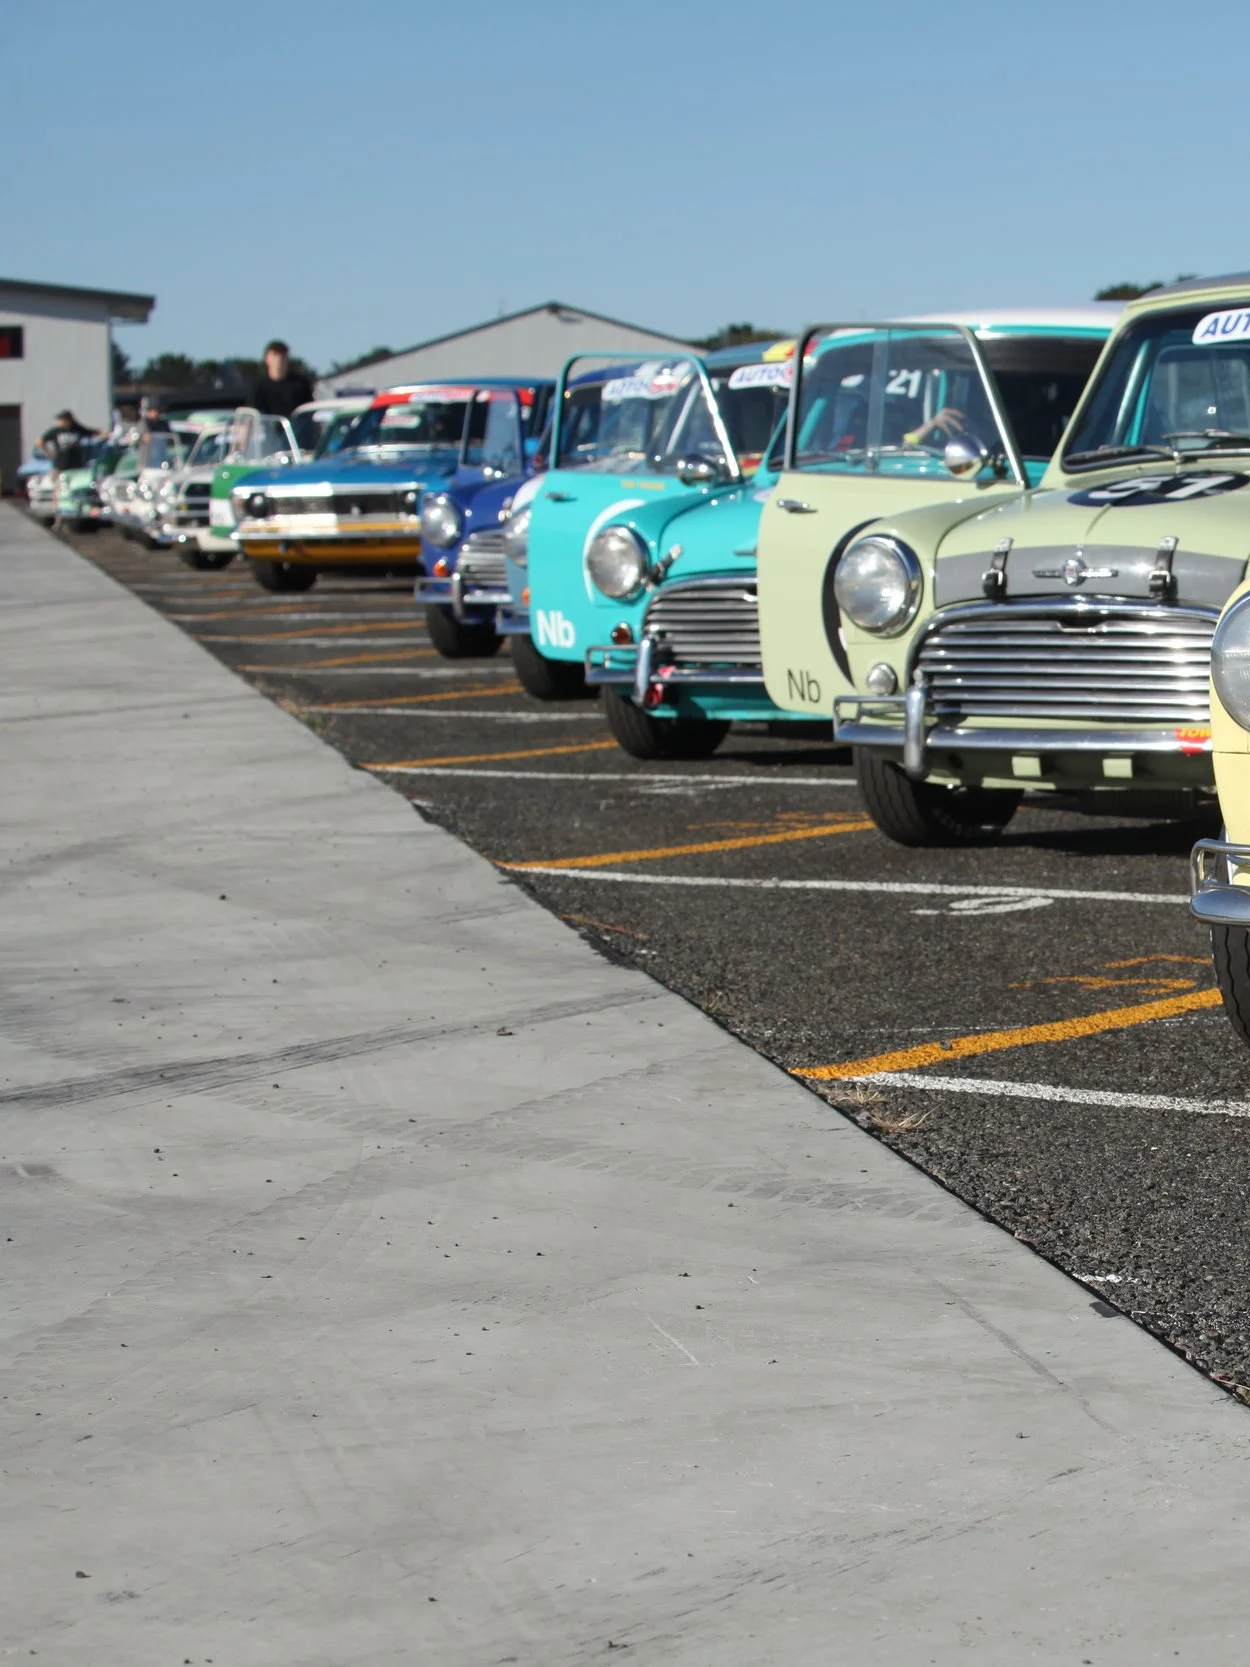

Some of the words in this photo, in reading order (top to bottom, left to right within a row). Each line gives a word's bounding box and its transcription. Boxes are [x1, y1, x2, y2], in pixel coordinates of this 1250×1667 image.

[885, 369, 922, 398] 21
[536, 609, 576, 648] Nb
[787, 668, 821, 704] Nb
